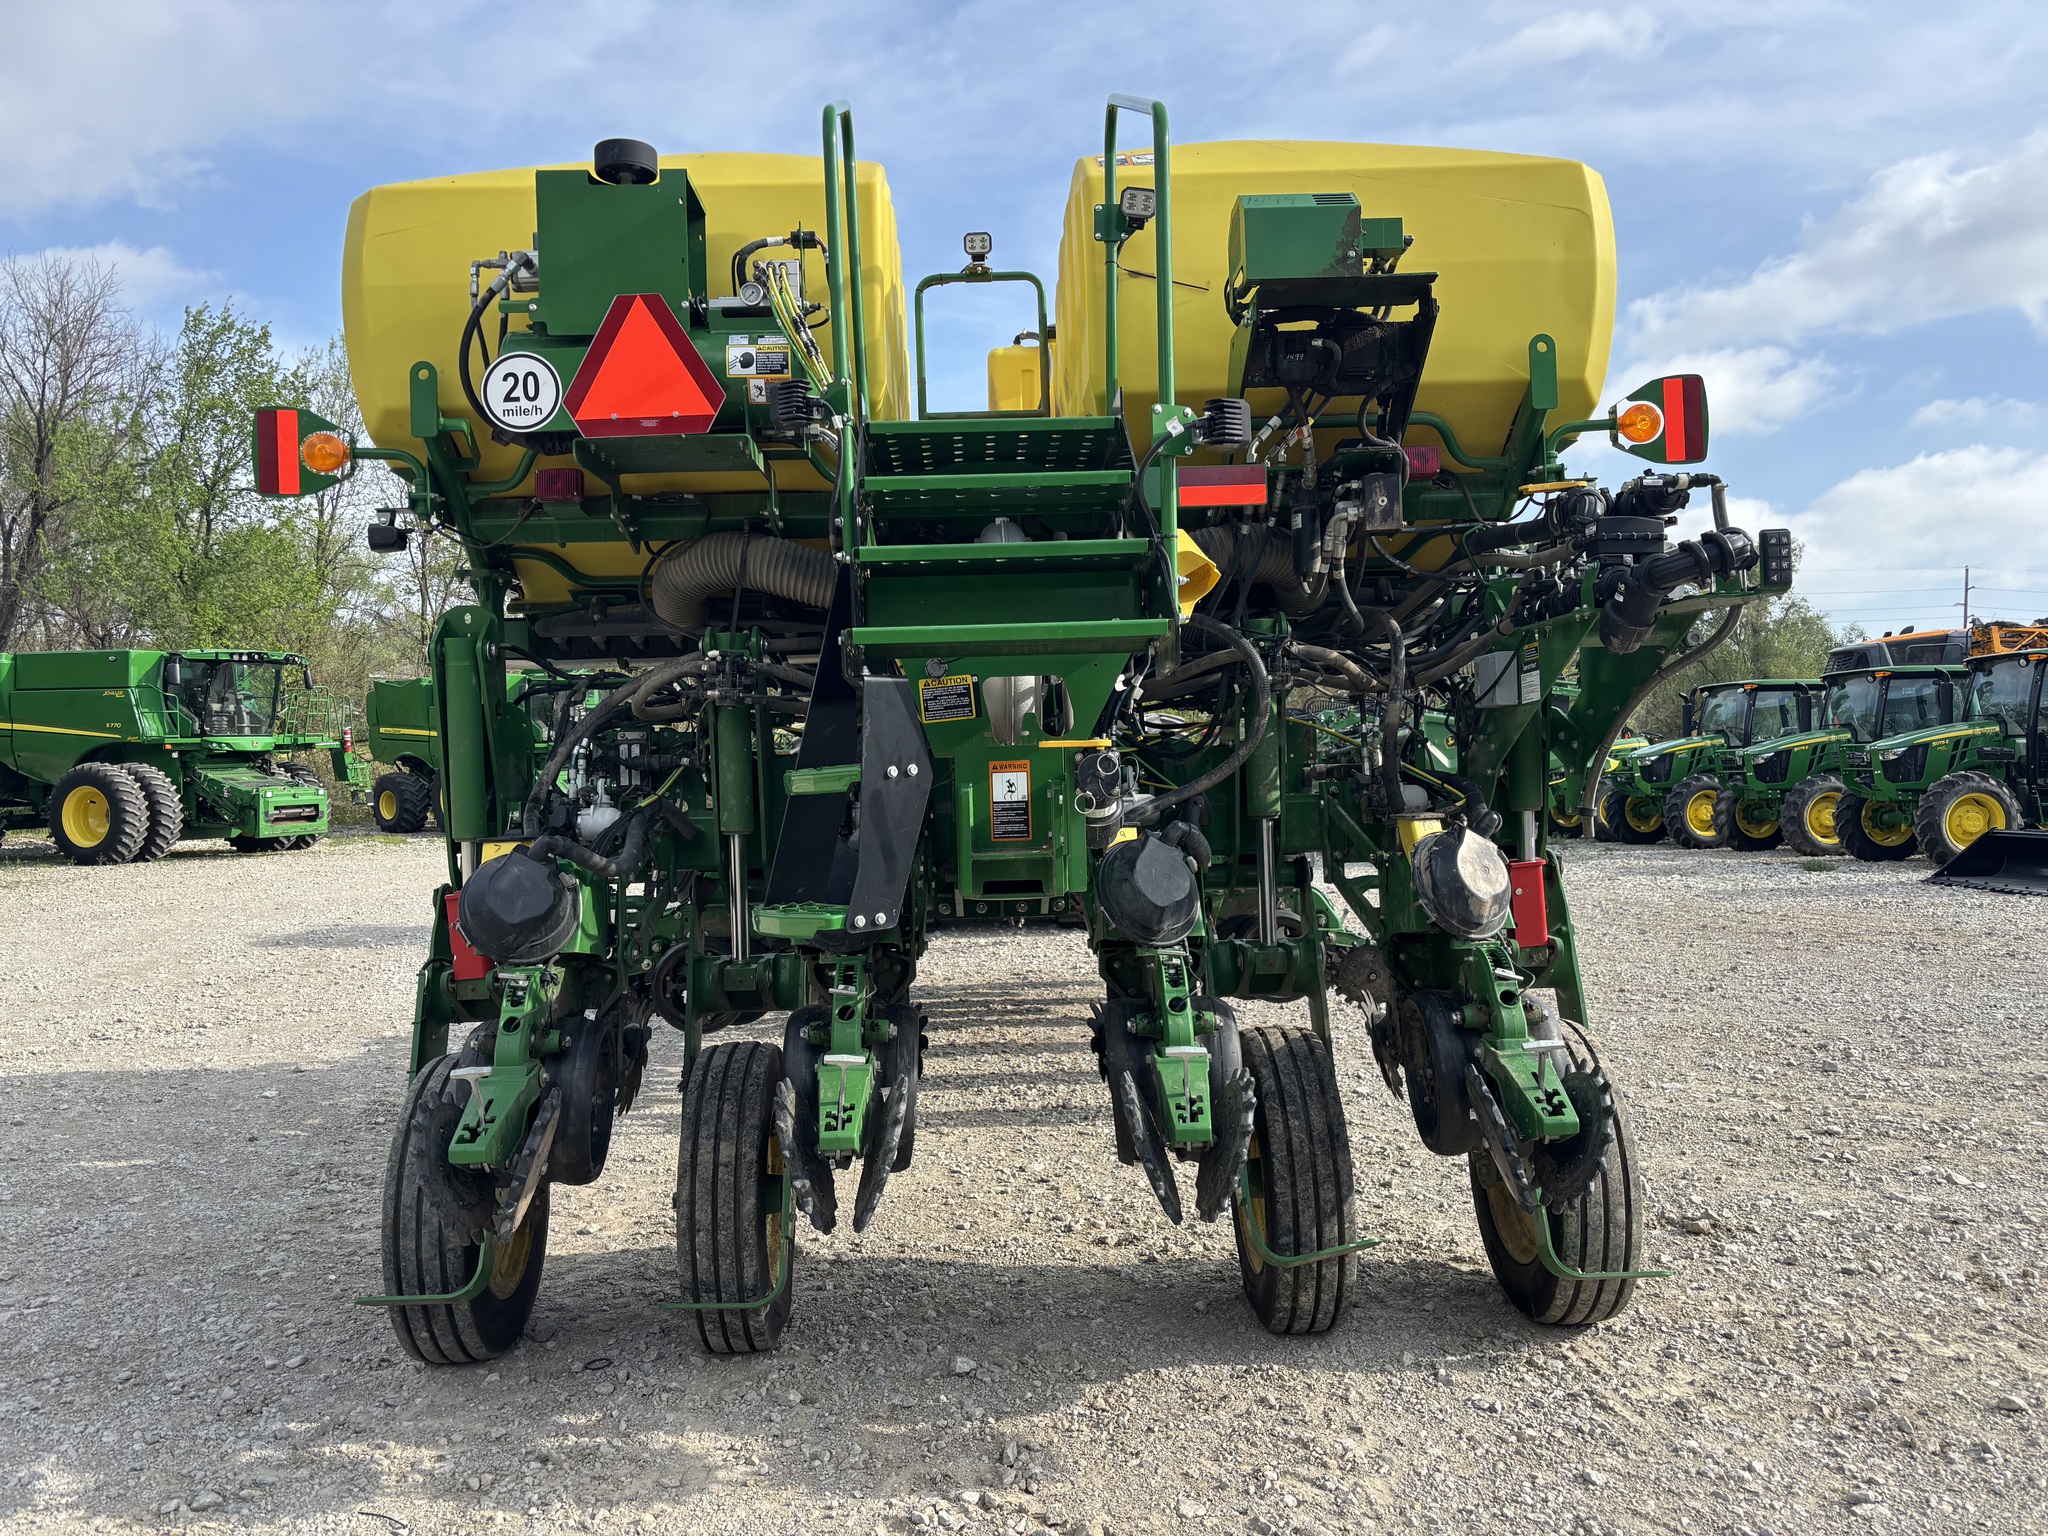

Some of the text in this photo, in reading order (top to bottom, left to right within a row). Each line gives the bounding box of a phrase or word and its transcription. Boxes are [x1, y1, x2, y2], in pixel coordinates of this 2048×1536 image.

[502, 371, 540, 403] 20
[502, 405, 543, 417] mile/h
[930, 676, 968, 687] CAUTION
